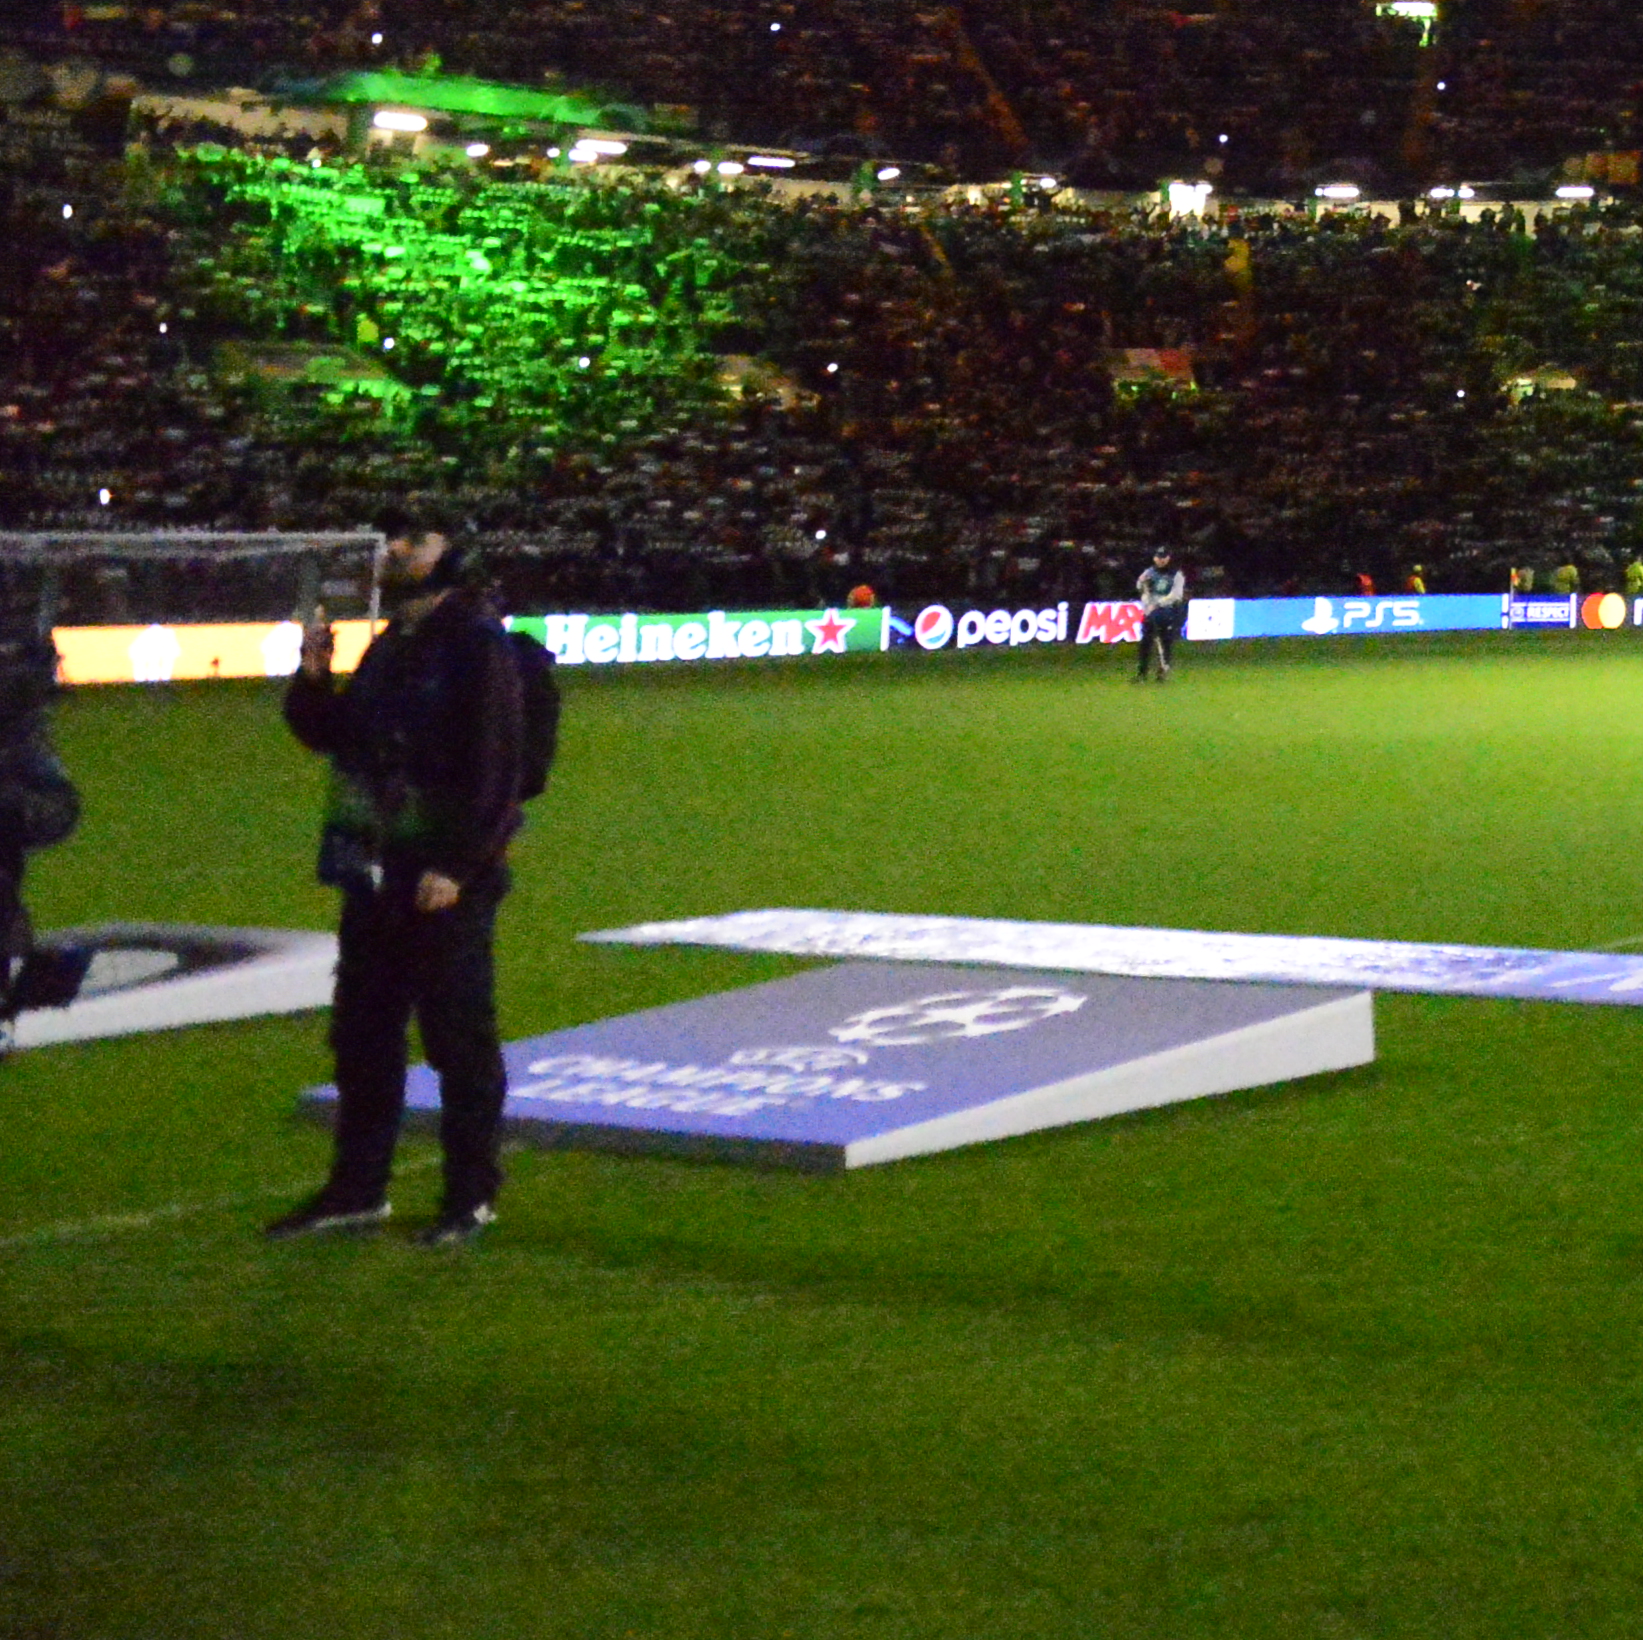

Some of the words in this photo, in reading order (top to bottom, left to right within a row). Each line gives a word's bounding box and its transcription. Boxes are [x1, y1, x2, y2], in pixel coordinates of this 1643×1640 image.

[545, 610, 805, 664] Heineken
[957, 601, 1069, 648] pepsi
[1343, 601, 1420, 628] PS5
